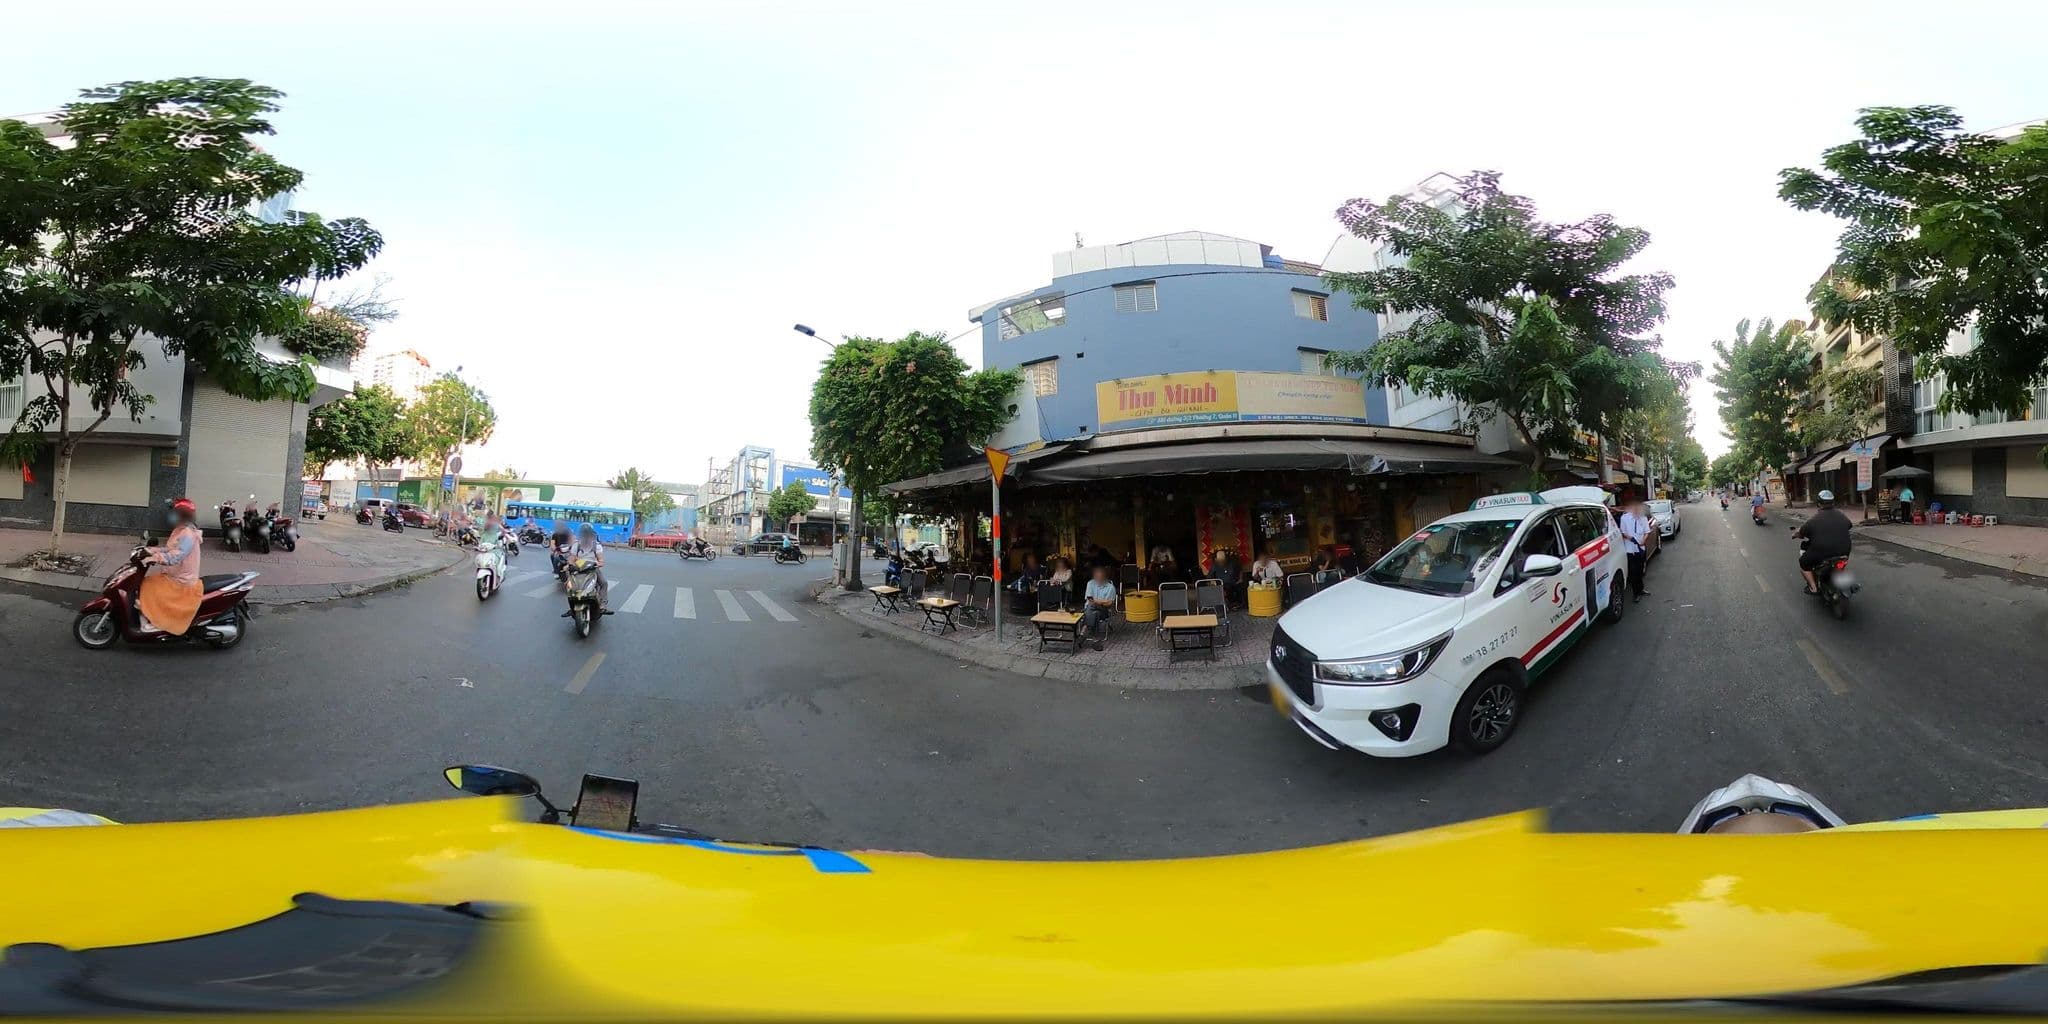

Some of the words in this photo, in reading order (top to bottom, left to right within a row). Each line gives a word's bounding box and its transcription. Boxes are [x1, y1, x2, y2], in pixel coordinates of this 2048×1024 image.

[1118, 389, 1156, 411] Thu
[1164, 382, 1217, 405] Minh
[1489, 638, 1499, 651] 27
